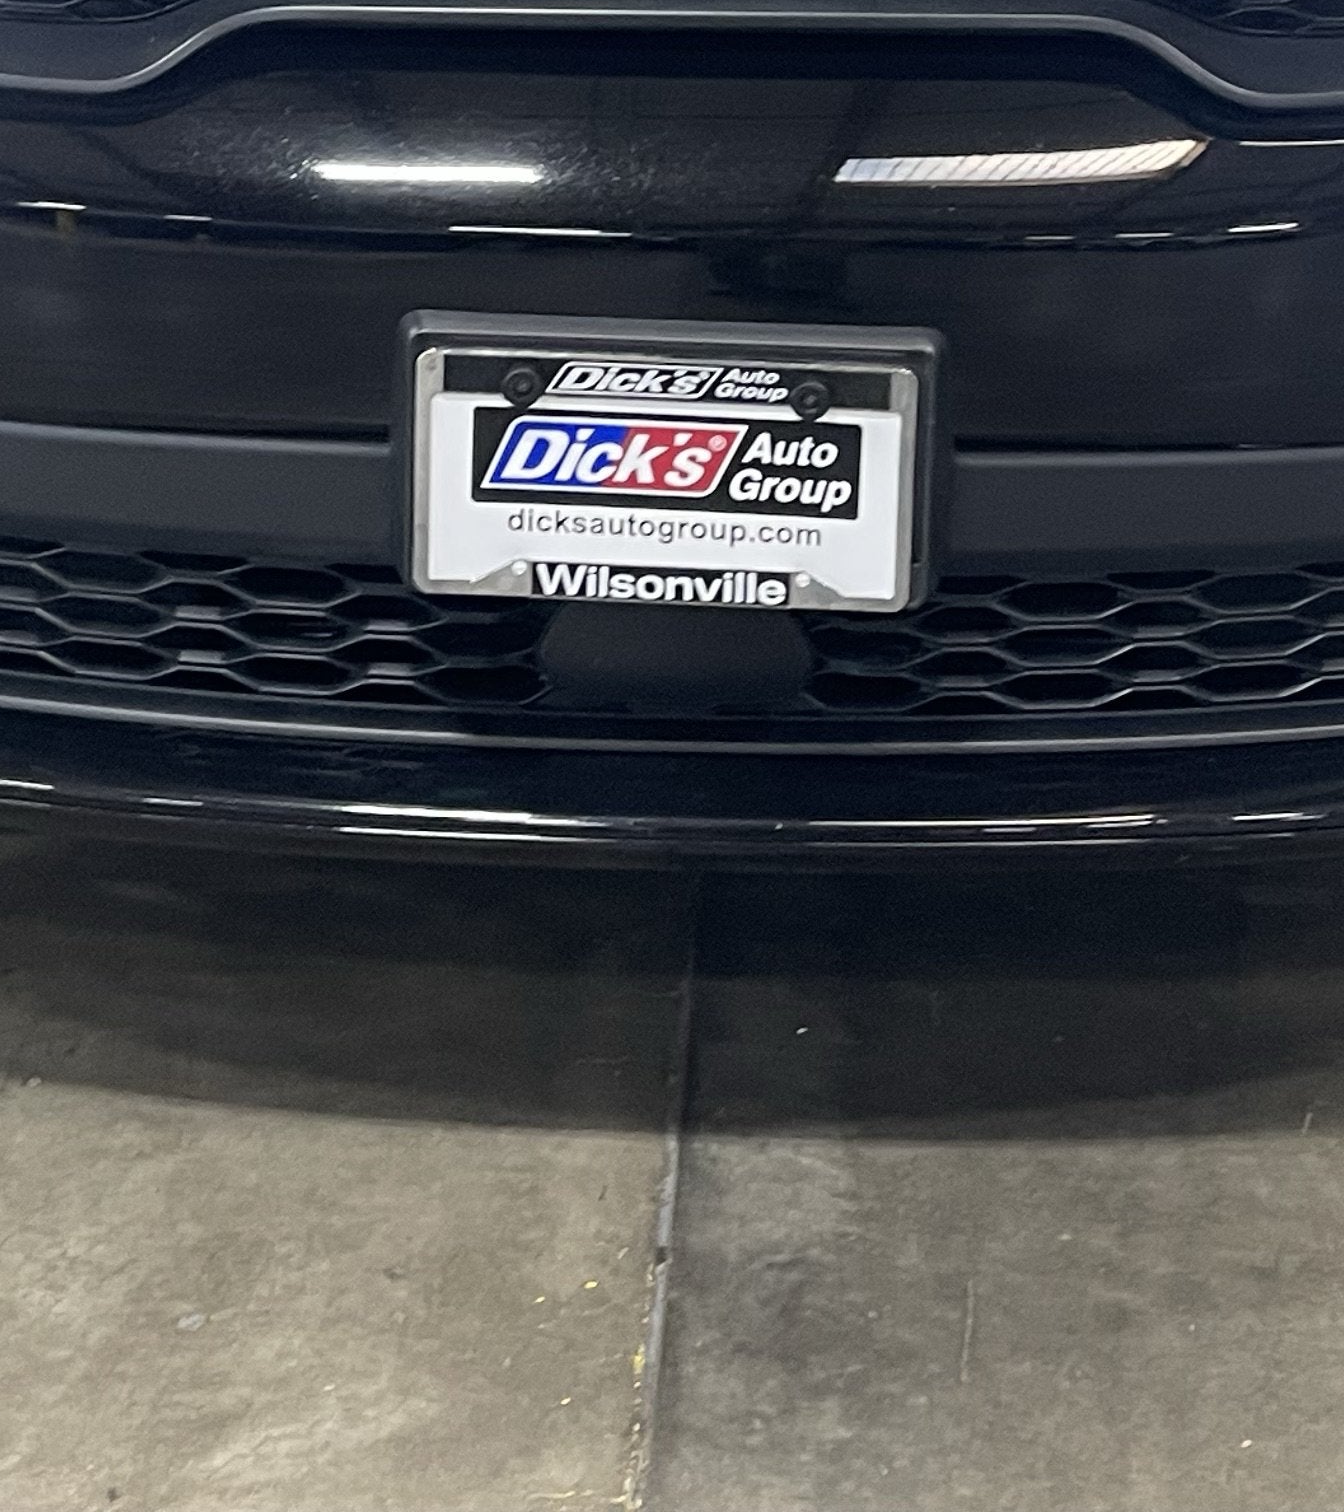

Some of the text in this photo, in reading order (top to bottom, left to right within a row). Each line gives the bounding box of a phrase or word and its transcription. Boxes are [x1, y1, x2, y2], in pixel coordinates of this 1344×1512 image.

[558, 366, 781, 395] Dick's Auto
[713, 382, 789, 403] Group
[499, 427, 839, 487] Dick's Auto
[728, 468, 853, 513] Group
[507, 508, 822, 547] dicksautogroup.com
[535, 562, 788, 606] Wilsonville
